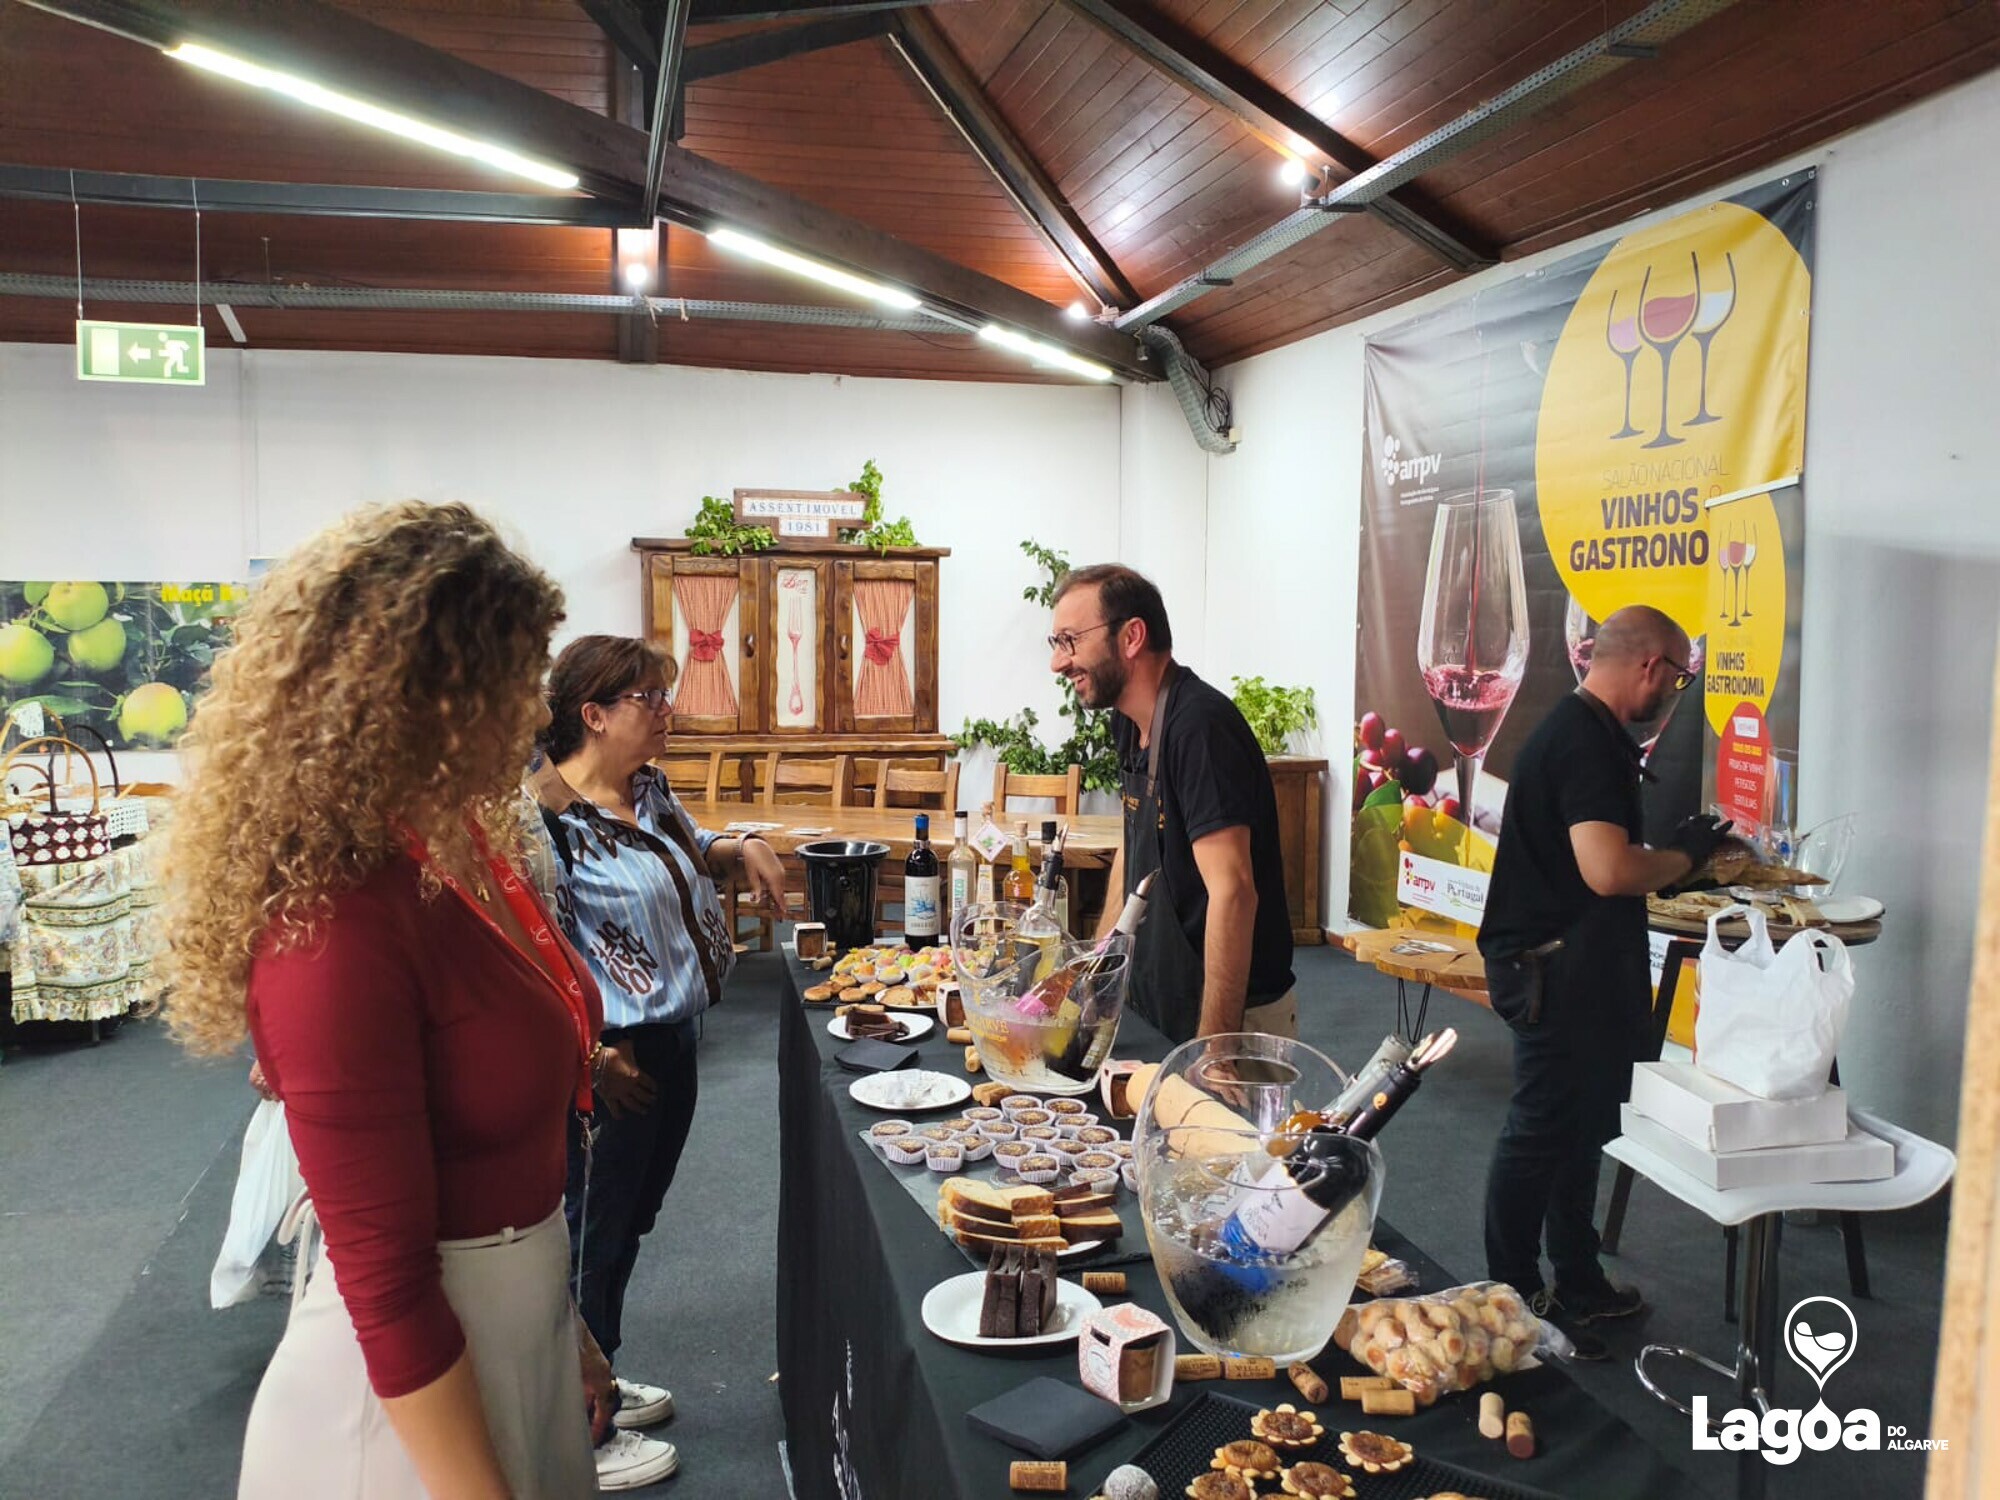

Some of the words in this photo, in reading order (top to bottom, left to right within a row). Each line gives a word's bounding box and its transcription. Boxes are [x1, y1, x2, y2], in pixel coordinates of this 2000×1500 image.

[1603, 463, 1648, 490] SALÃO
[1650, 455, 1731, 482] NACIONAL
[748, 501, 857, 516] ASSENTIMOVEL
[1601, 487, 1699, 530] VINHOS
[161, 583, 214, 607] Maçã
[1716, 651, 1745, 672] VINHOS
[1706, 675, 1765, 698] GASTRONOMIA
